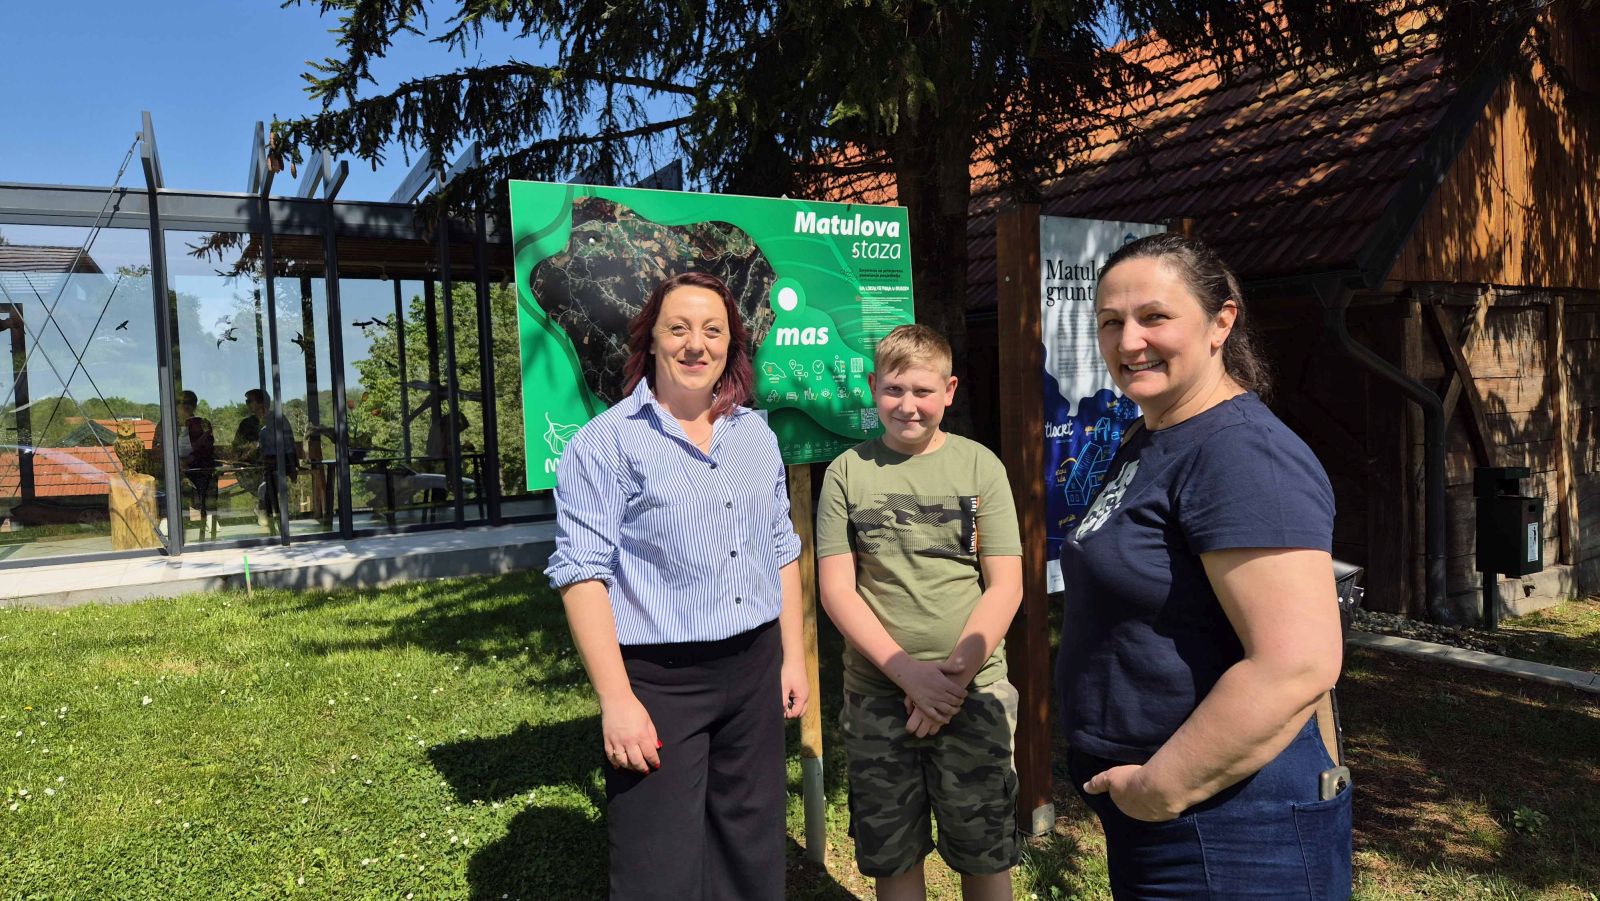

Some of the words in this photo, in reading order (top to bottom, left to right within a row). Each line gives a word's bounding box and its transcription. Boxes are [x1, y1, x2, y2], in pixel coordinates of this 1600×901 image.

[794, 211, 900, 238] Matulova
[852, 240, 901, 259] staza
[1046, 285, 1094, 307] grunt
[776, 326, 829, 346] mas
